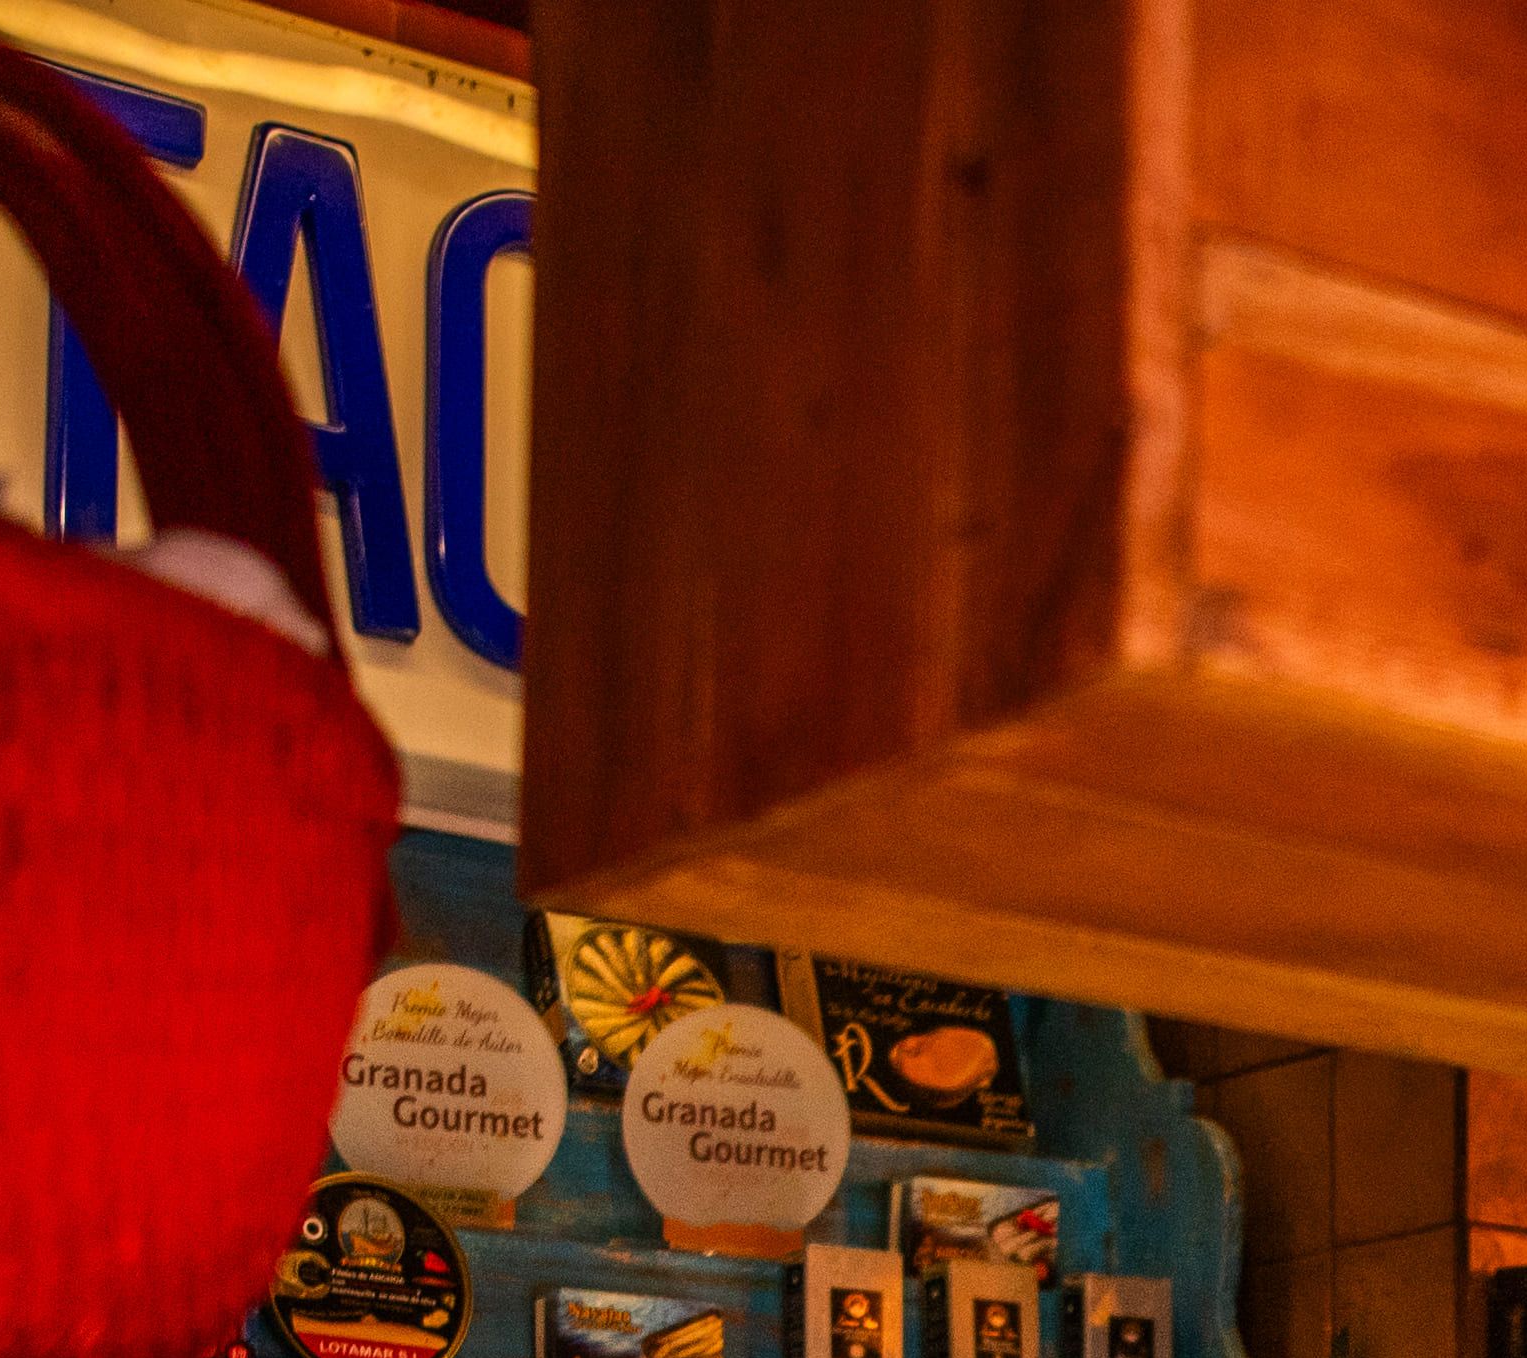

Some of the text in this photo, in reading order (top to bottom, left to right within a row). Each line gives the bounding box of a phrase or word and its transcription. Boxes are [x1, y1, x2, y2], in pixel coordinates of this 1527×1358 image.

[342, 1054, 487, 1097] Granada
[393, 1096, 543, 1139] Gourmet
[642, 1091, 776, 1132] Granada
[689, 1131, 828, 1173] Gourmet
